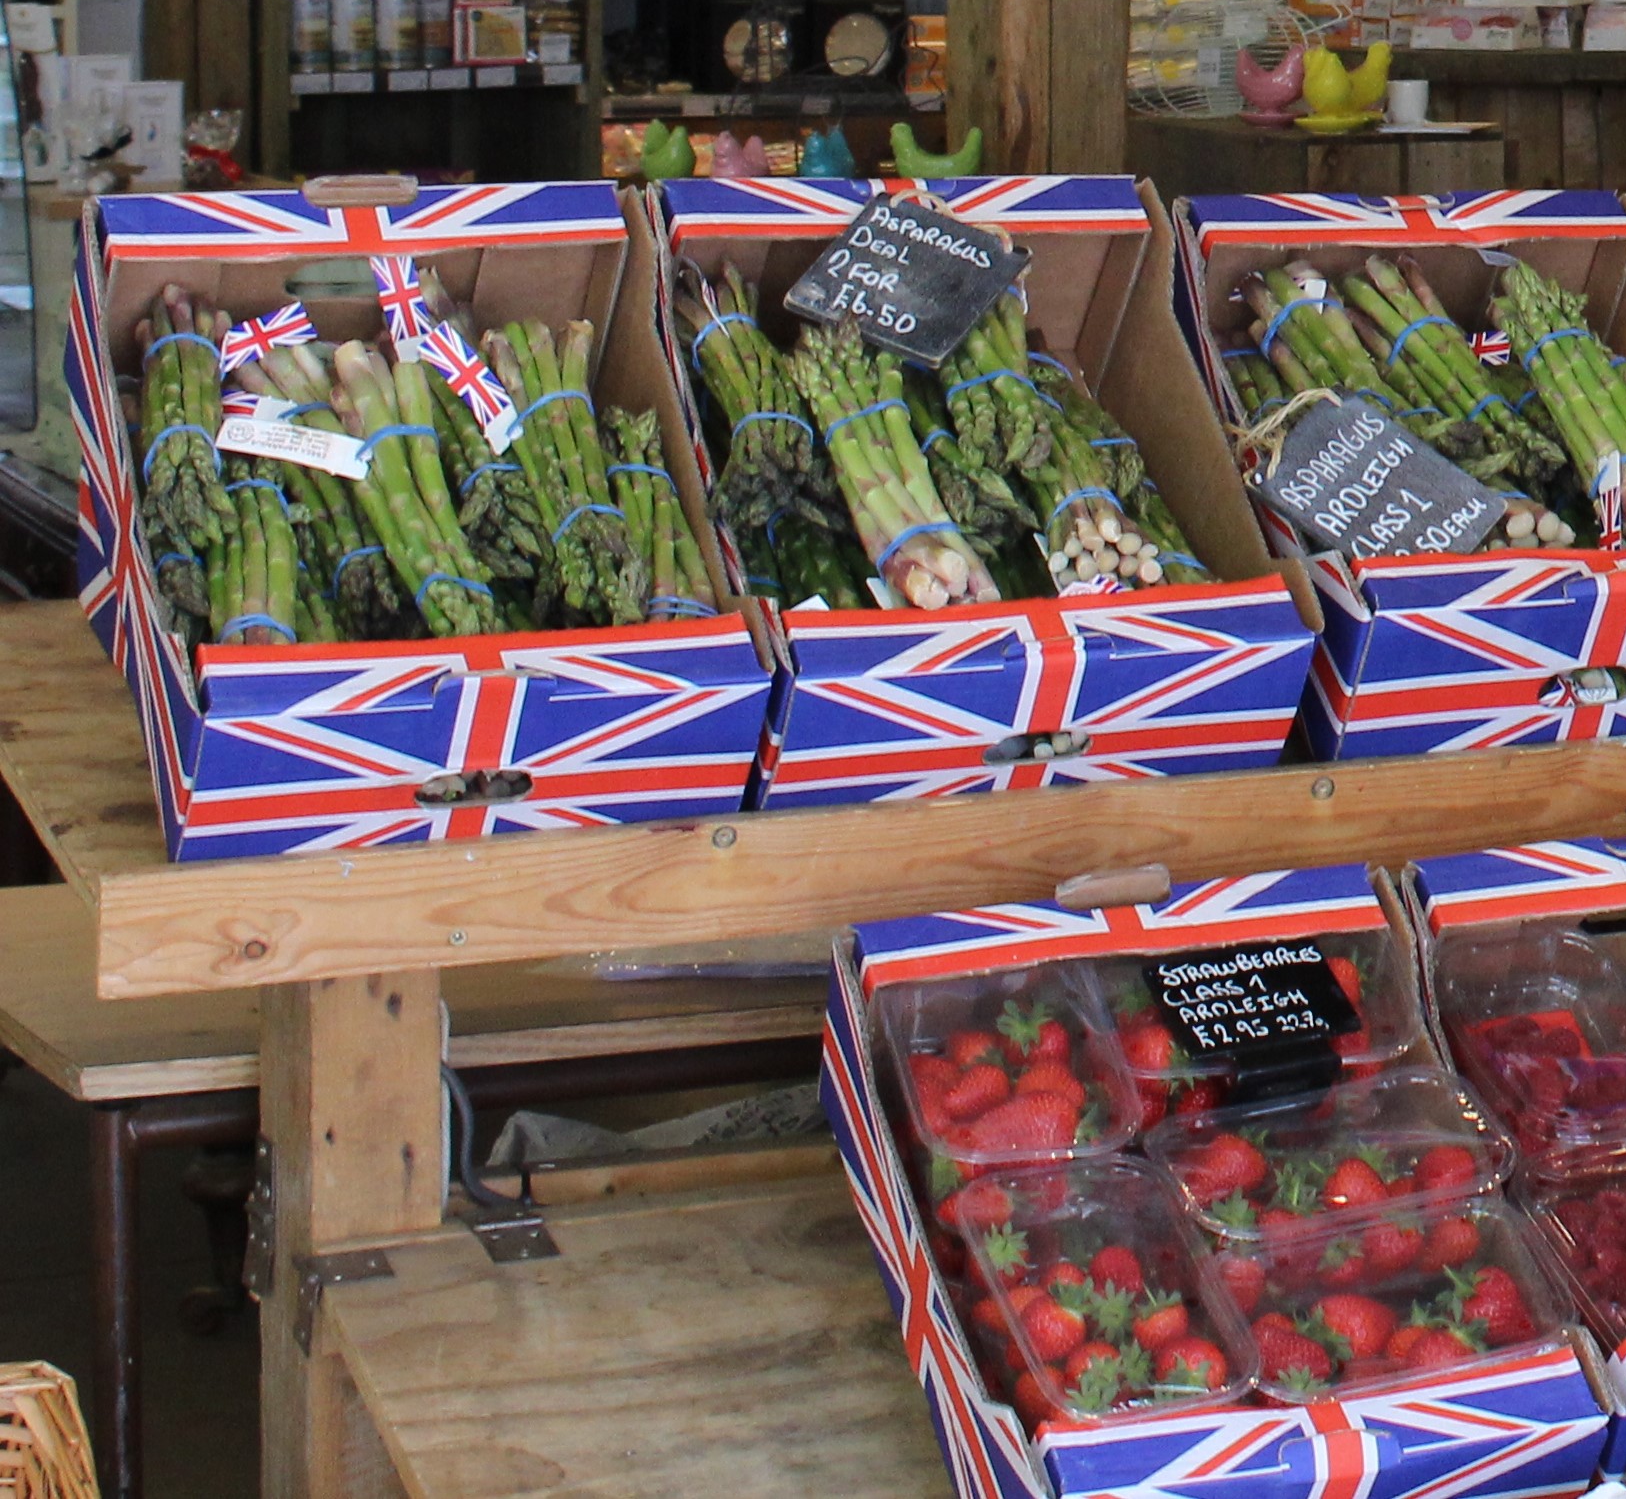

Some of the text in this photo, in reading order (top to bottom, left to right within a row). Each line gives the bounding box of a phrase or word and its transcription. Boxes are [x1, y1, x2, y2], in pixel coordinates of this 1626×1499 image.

[848, 225, 911, 266] DEAL
[870, 204, 993, 270] ASPARAGUS
[828, 248, 897, 294] 2 FOR
[832, 282, 916, 335] £6.50
[1279, 411, 1385, 510] ASPARAGUS
[1351, 488, 1434, 560] CLASS 1
[1158, 945, 1322, 987] STRAWBERRIES
[1163, 973, 1268, 1007] CLASS 1
[1192, 1018, 1269, 1049] £2.95
